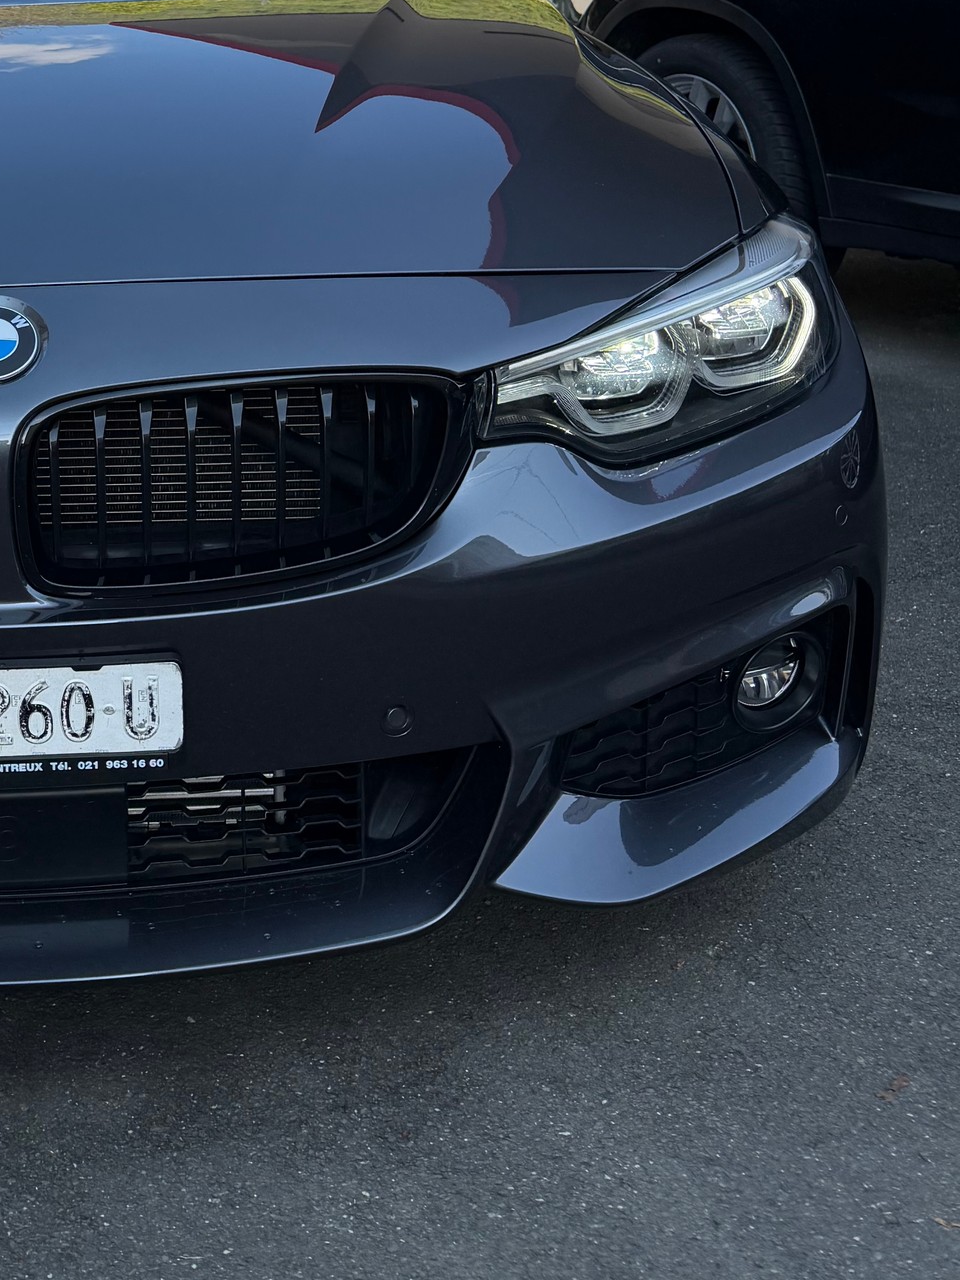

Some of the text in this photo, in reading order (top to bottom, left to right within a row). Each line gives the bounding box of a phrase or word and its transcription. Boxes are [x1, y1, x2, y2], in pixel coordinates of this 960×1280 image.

[50, 761, 72, 772] Tél.
[77, 761, 100, 771] 021
[106, 759, 129, 770] 963
[132, 759, 147, 769] 16
[149, 758, 165, 769] 60
